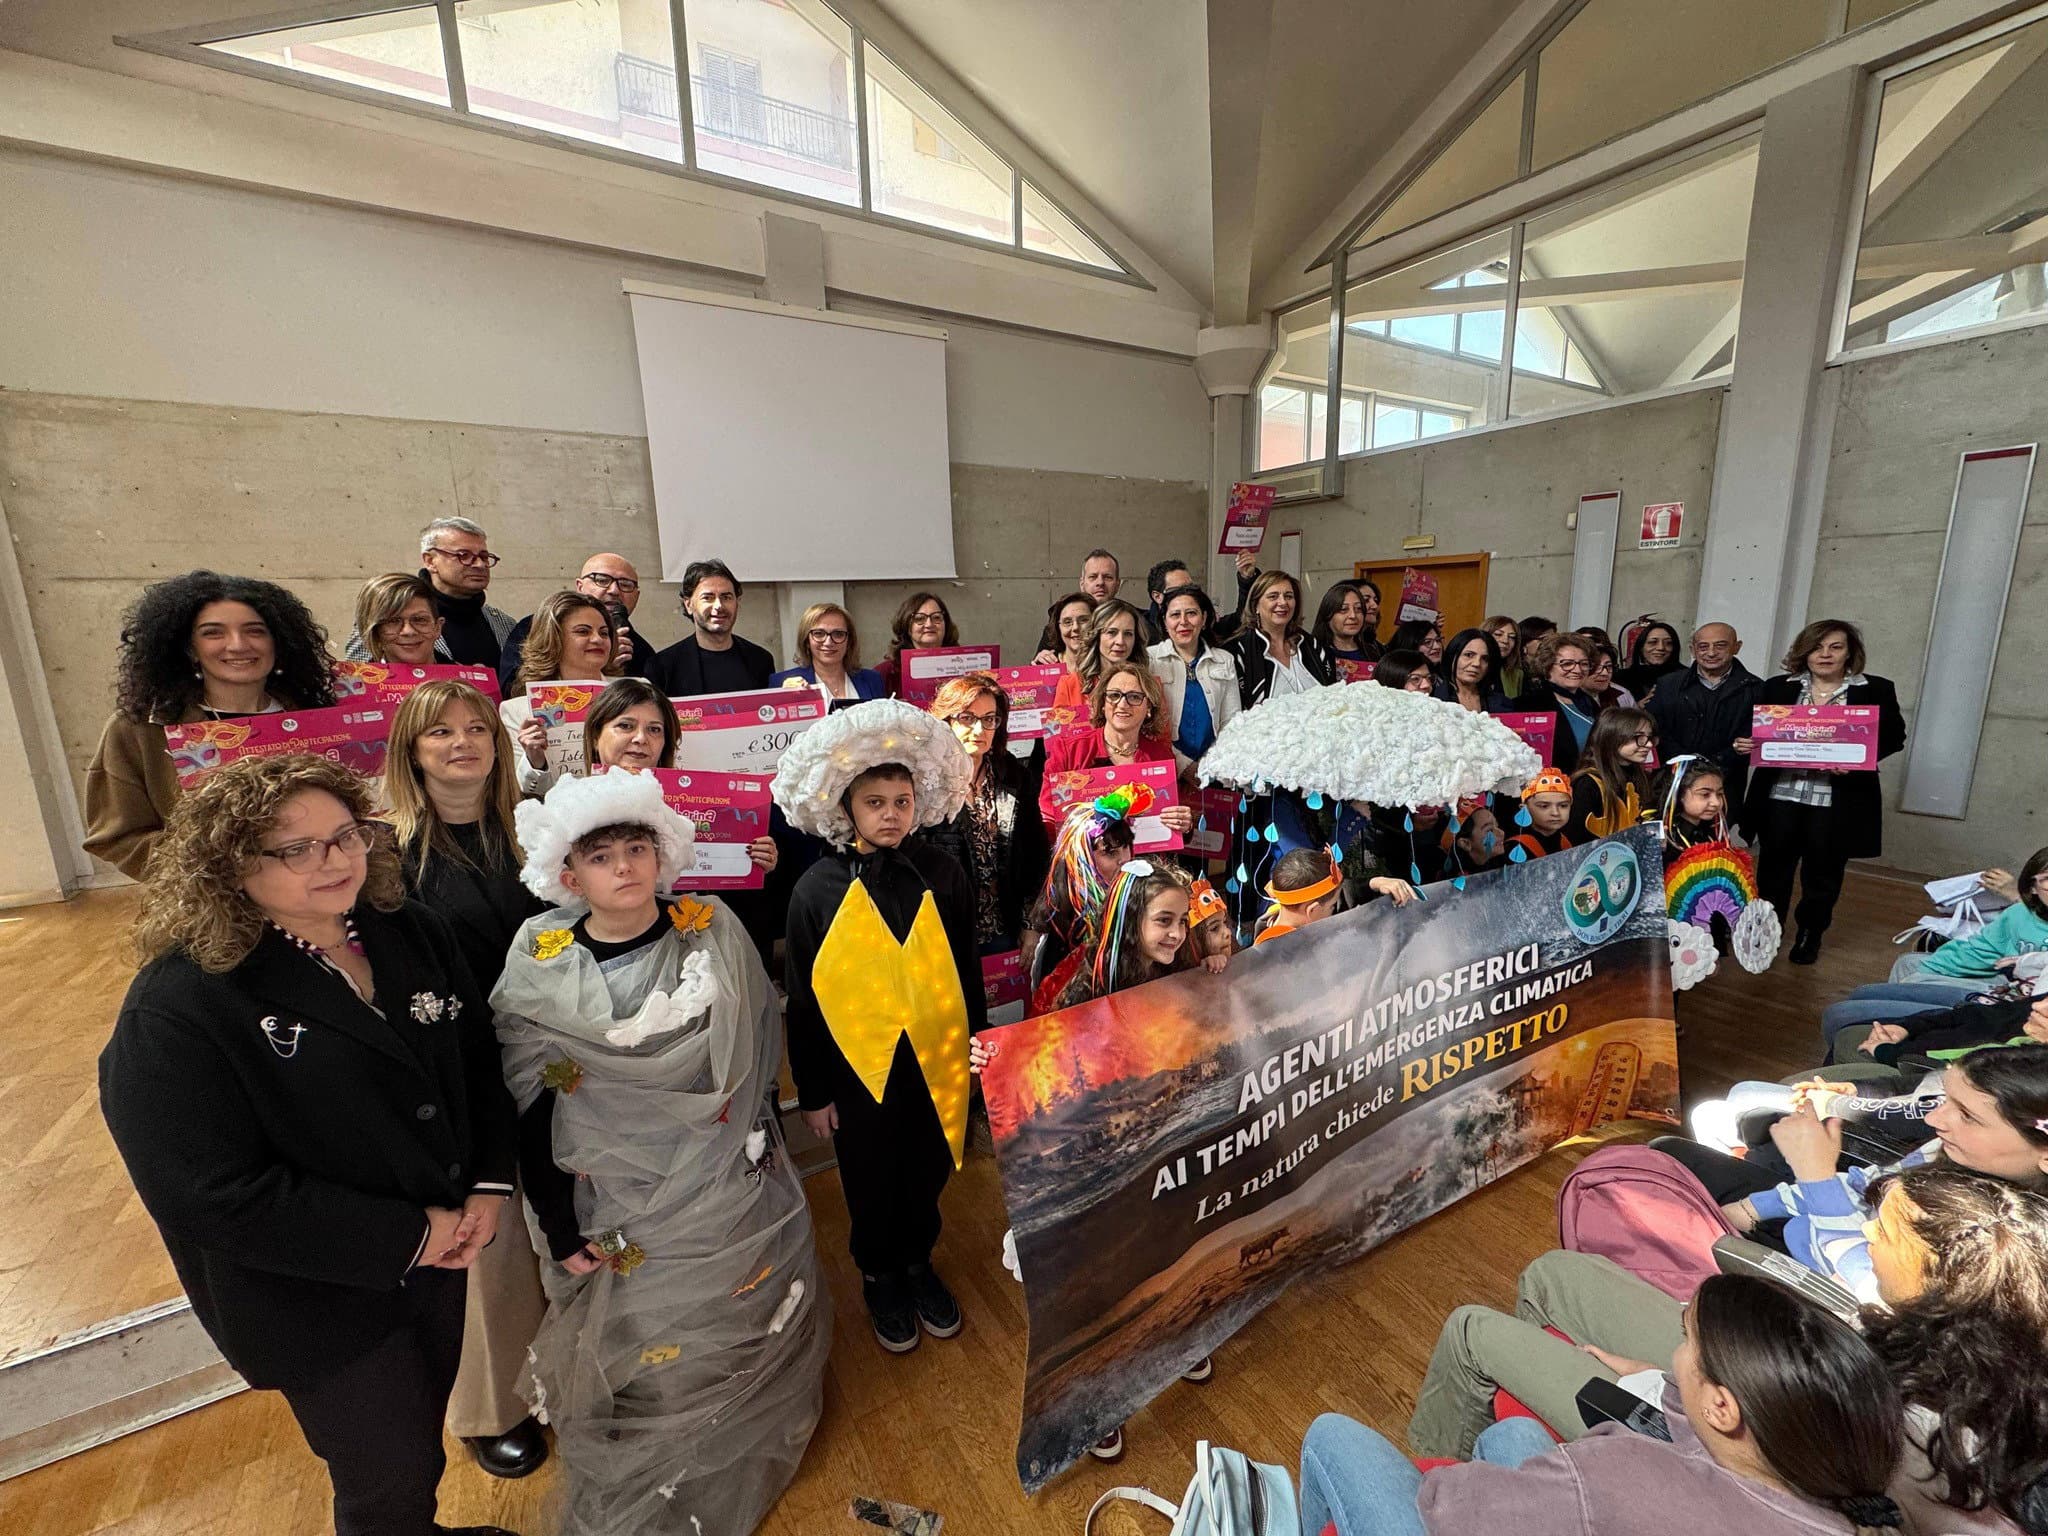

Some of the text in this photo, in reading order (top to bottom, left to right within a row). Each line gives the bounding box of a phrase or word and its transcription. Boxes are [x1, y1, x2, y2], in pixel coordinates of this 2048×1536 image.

[1640, 539, 1678, 547] ESTINTORE
[1152, 960, 1593, 1200] AI TEMPI DELL'EMERGENZA CLIMATICA
[1194, 1191, 1232, 1224] La
[1240, 1133, 1320, 1198] natura
[1325, 1085, 1394, 1140] chiede
[1401, 1003, 1568, 1103] RISPETTO
[1238, 943, 1539, 1114] AGENTI ATMOSFERICI
[1849, 1098, 1941, 1120] didas
